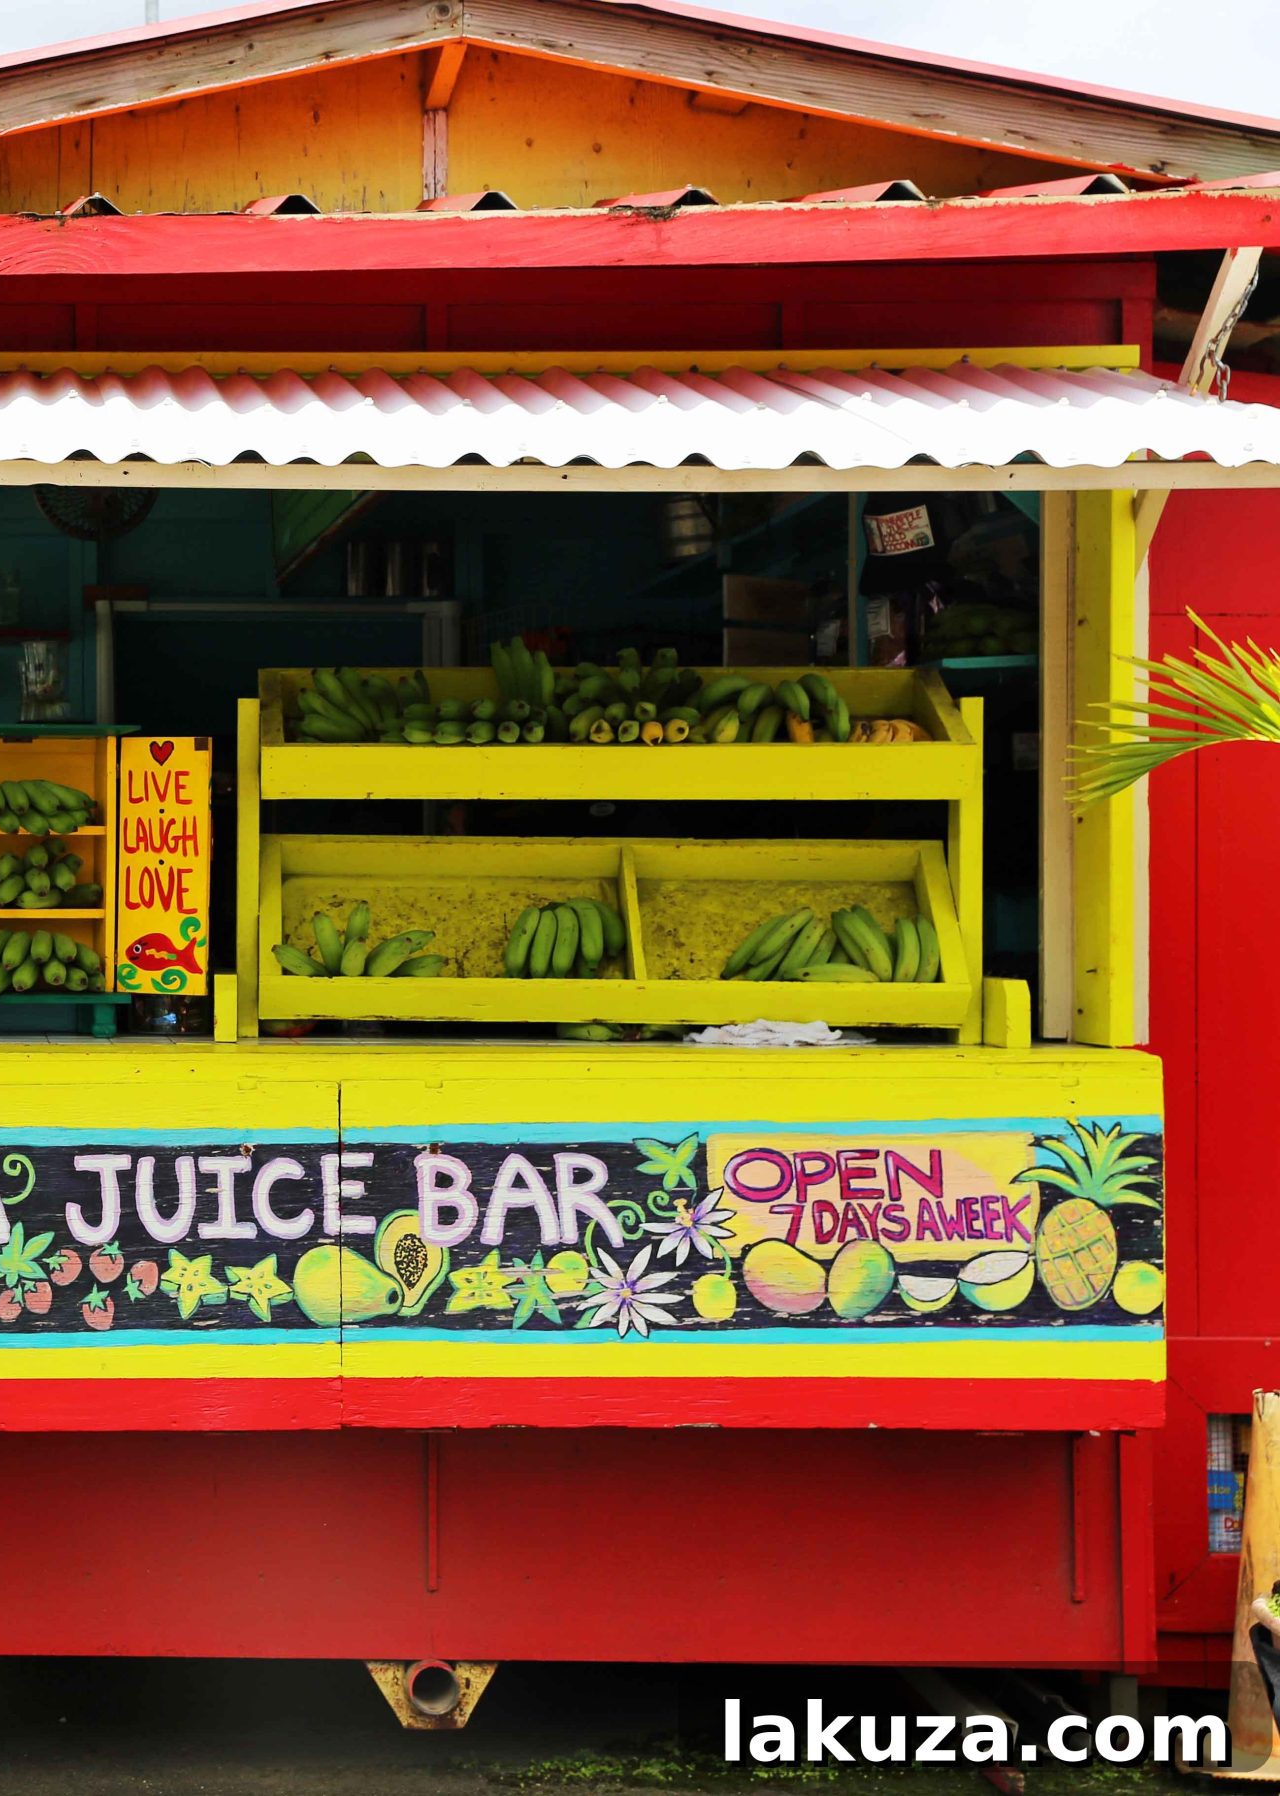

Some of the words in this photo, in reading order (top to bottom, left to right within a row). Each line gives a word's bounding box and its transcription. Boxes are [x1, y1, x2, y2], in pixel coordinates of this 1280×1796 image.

[127, 769, 192, 804] LIVE
[122, 815, 199, 858] LAUGH
[124, 865, 198, 915] LOVE
[723, 1148, 943, 1203] OPEN
[65, 1153, 375, 1246] JUICE
[413, 1152, 625, 1248] BAR
[768, 1203, 805, 1245] 7
[812, 1199, 911, 1243] DAYS
